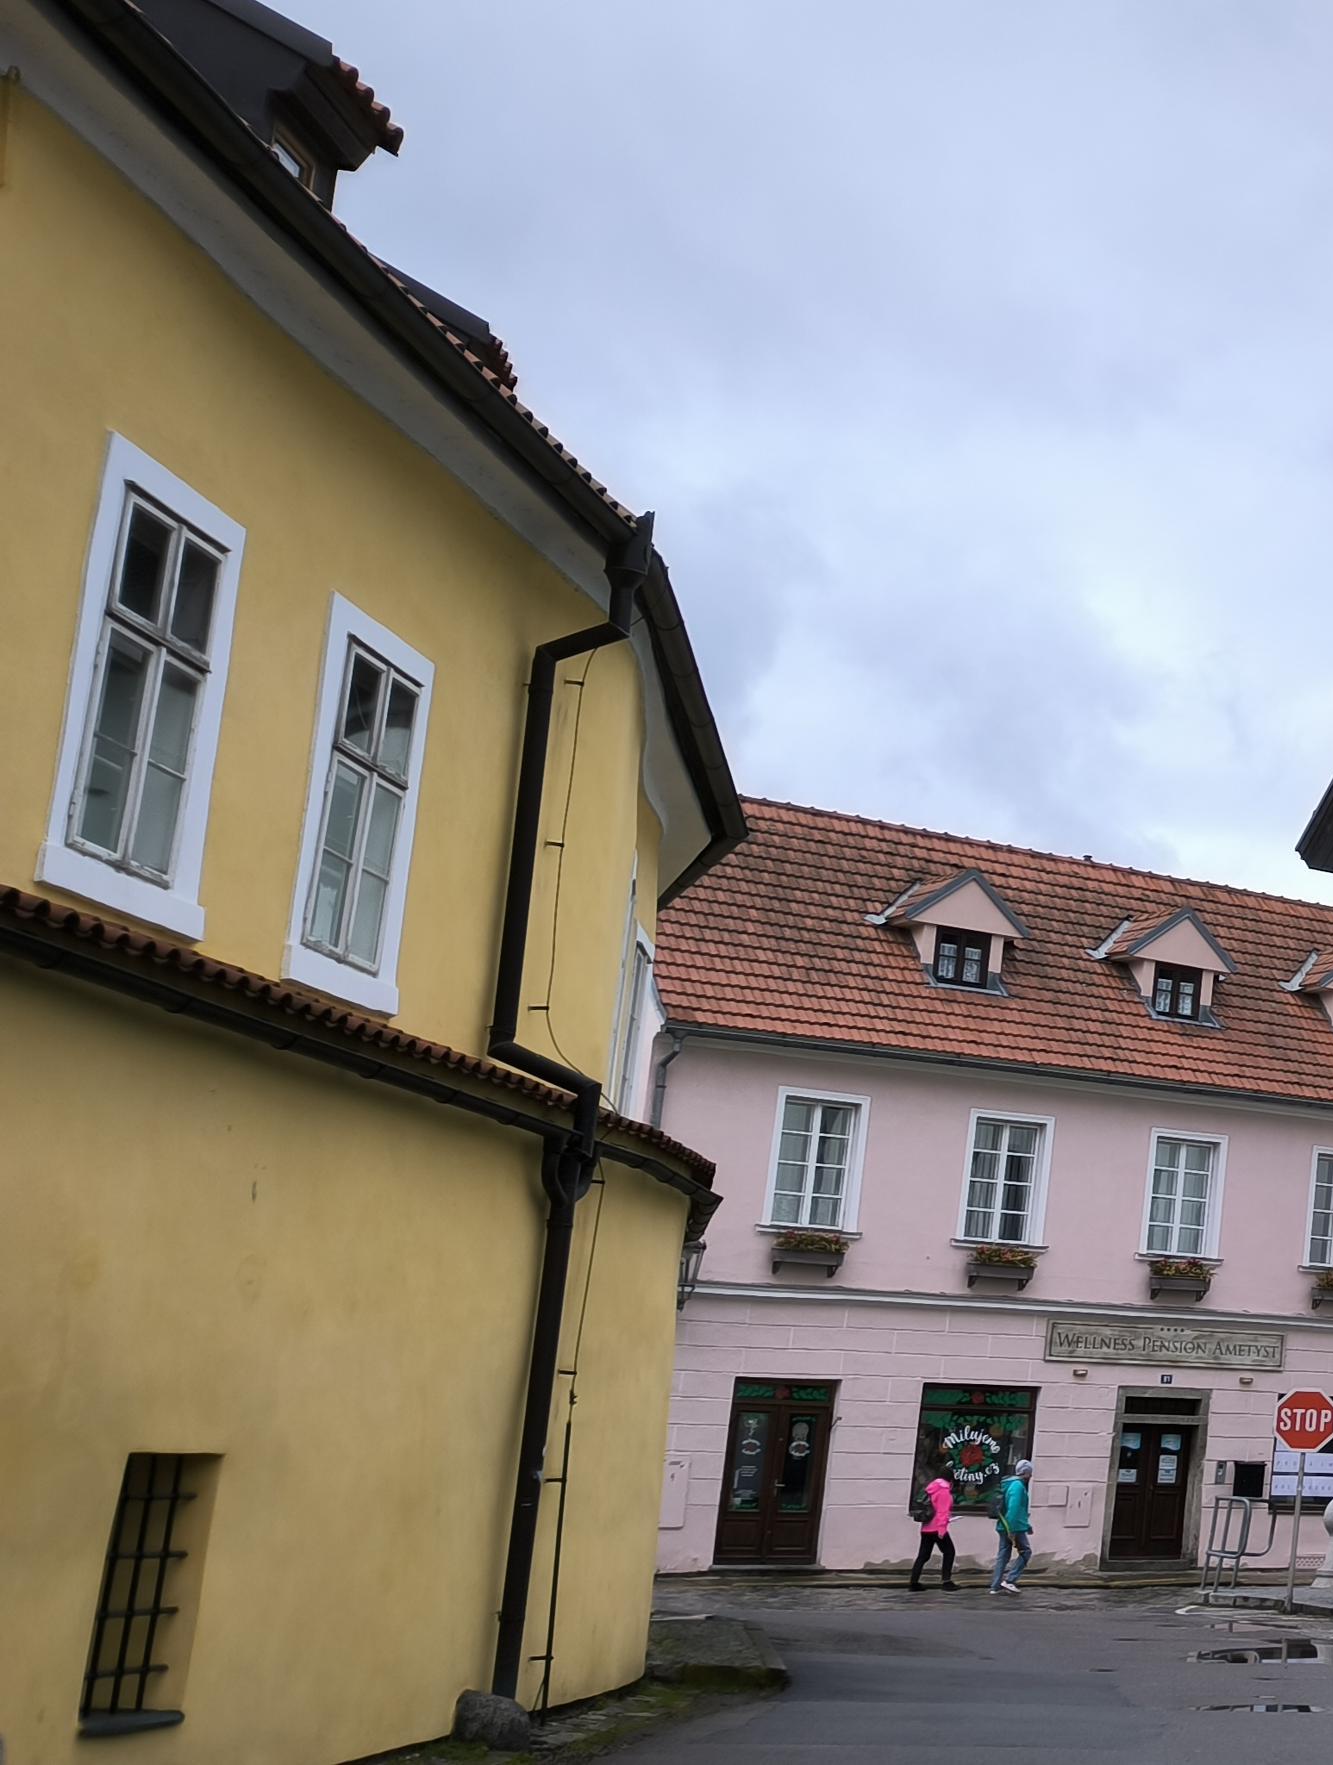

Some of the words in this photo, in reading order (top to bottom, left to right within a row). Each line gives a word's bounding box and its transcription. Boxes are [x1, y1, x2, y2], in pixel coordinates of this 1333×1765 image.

[1057, 1331, 1136, 1351] WELLNESS
[1142, 1336, 1209, 1355] PENSION
[1212, 1341, 1279, 1359] AMETYST
[1279, 1407, 1332, 1432] STOP
